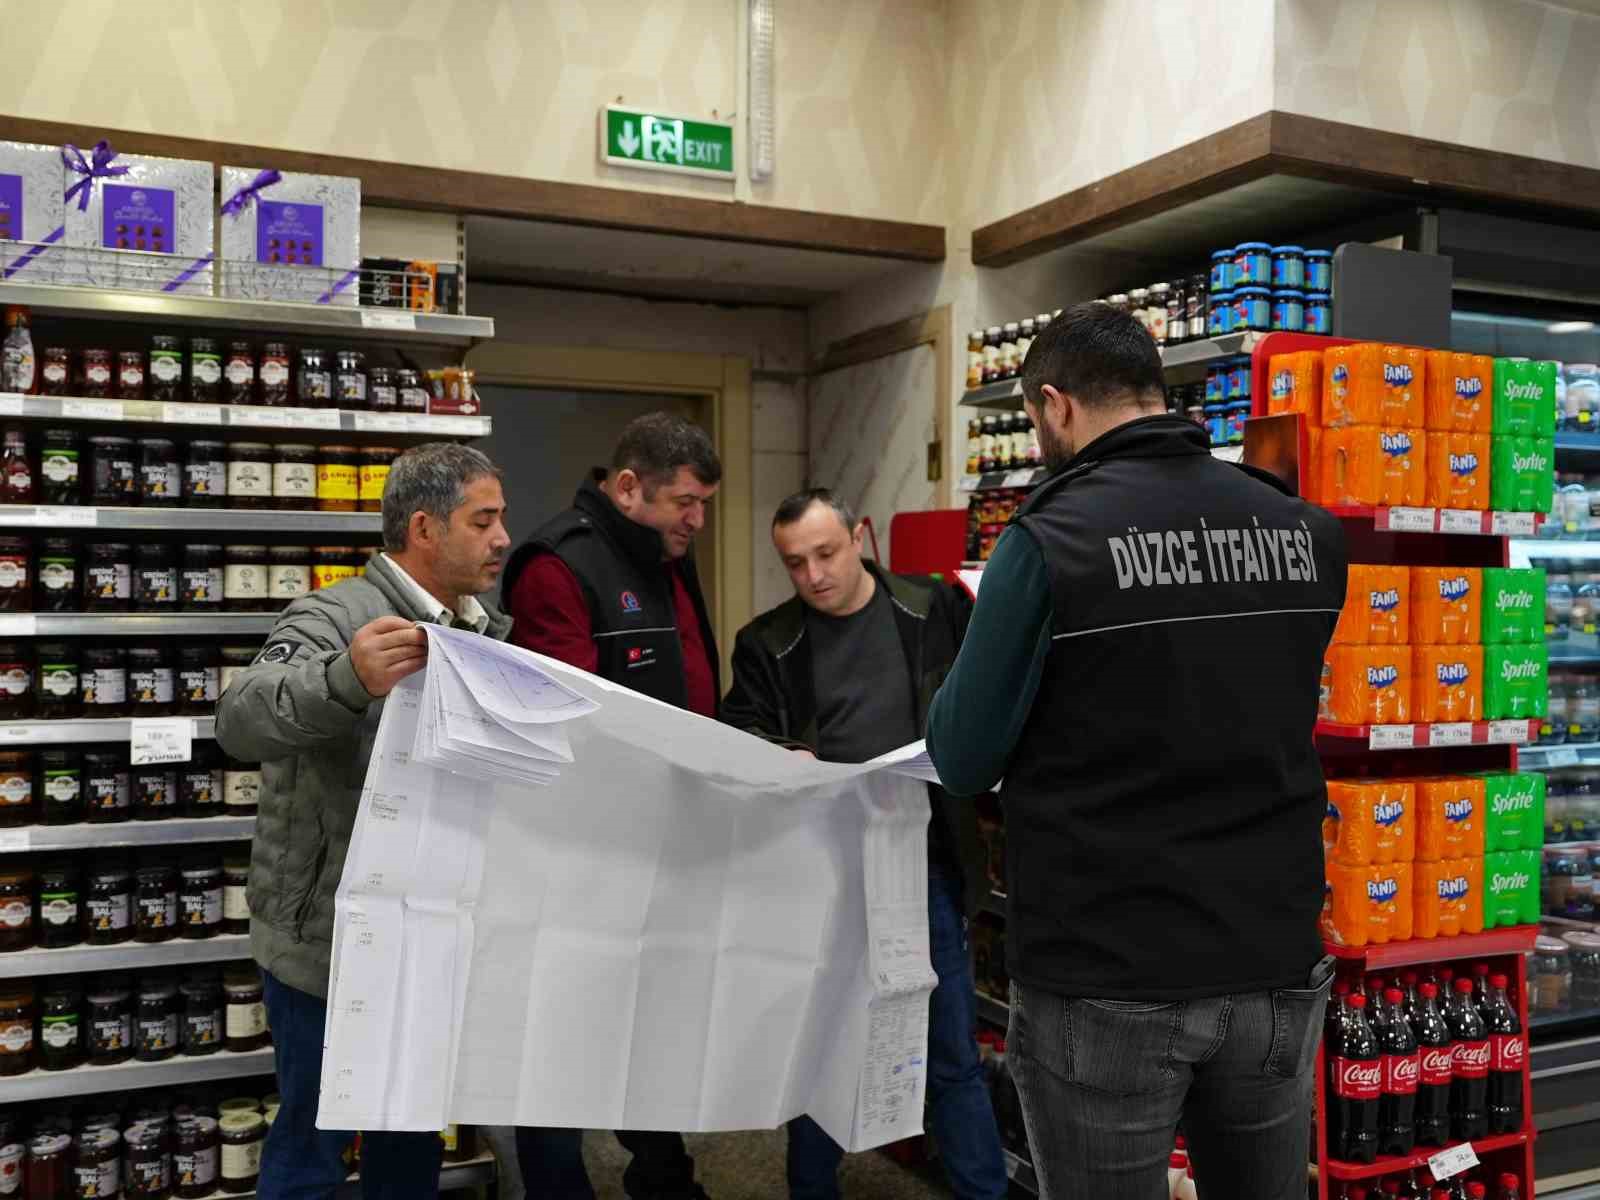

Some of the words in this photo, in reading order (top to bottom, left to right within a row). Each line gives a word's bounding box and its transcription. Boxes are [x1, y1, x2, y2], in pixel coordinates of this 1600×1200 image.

[685, 139, 722, 164] EXIT
[1384, 363, 1413, 380] FANTA
[1455, 377, 1482, 393] FANTA
[1504, 379, 1543, 401] Sprite
[1380, 433, 1411, 449] FANTA
[1450, 454, 1477, 471] FANTA
[1512, 452, 1547, 473] Sprite
[1108, 526, 1203, 589] DÜZCE
[1200, 516, 1318, 583] İTFAİYESİ
[1440, 576, 1469, 595] FANTA
[1370, 589, 1399, 607] FANTA
[1496, 589, 1533, 610] Sprite
[1368, 665, 1397, 683] FANTA
[1437, 663, 1468, 681] FANTA
[1500, 660, 1540, 681] Sprite
[1374, 800, 1403, 821] FANTA
[1444, 799, 1472, 818] FANTA
[1492, 794, 1534, 815] Sprite
[1367, 878, 1397, 897] FANTA
[1437, 877, 1468, 896] FANTA
[1490, 871, 1530, 892] Sprite
